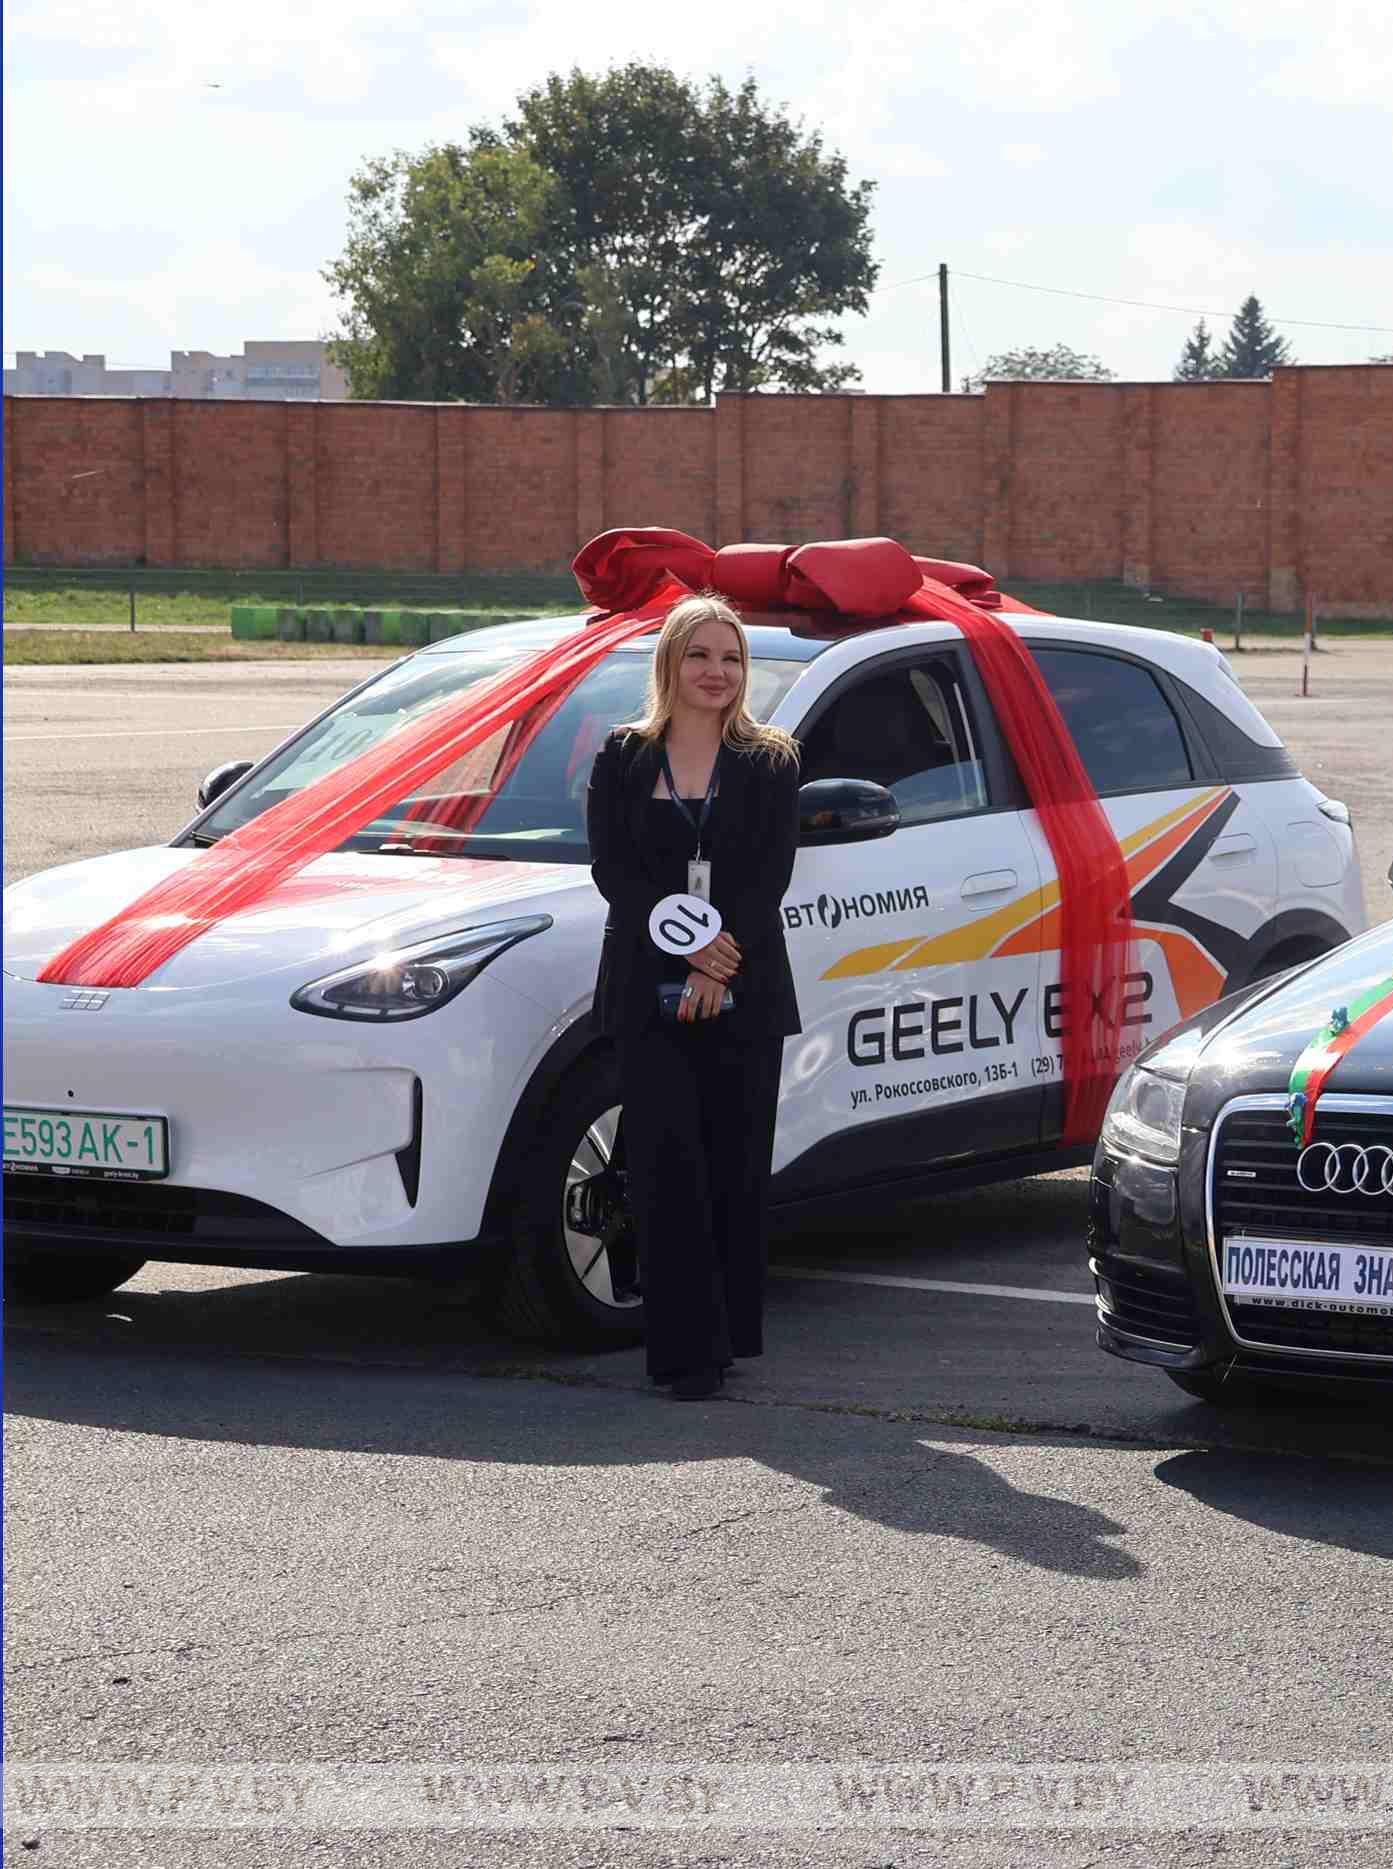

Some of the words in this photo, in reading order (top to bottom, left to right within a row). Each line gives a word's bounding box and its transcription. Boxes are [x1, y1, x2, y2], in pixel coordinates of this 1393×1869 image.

[784, 886, 929, 929] ВТОНОМИЯ
[847, 987, 1028, 1067] GEELY
[850, 1088, 872, 1109] ул.
[875, 1071, 981, 1101] Рокоссовского,
[1031, 1054, 1054, 1078] (29)
[1227, 1246, 1341, 1291] ПОЛЕССКАЯ
